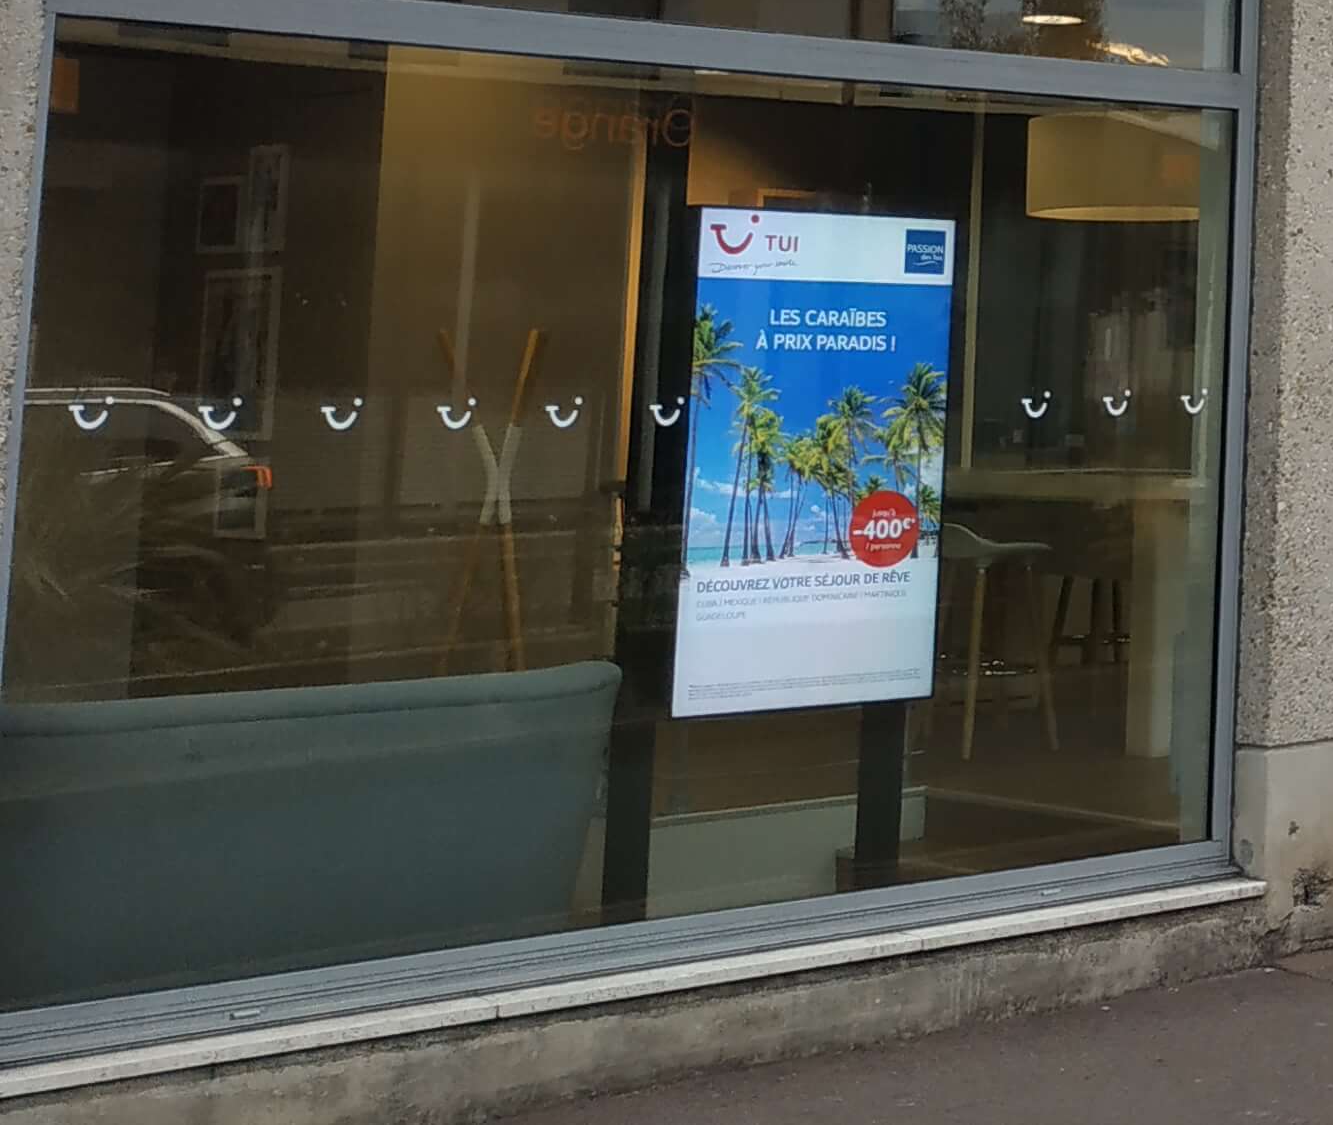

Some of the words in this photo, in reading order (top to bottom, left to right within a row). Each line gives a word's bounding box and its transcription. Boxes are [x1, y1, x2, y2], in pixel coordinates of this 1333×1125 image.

[765, 235, 799, 252] TUI
[907, 243, 944, 255] PASSION
[769, 308, 801, 327] LES
[804, 307, 887, 328] CARAÏBES
[756, 330, 768, 350] À
[773, 333, 813, 351] PRIX
[816, 333, 888, 351] PARADIS
[696, 578, 770, 594] DÉCOUVREZ
[773, 576, 812, 590] VOTRE
[814, 572, 860, 587] SÉJOUR
[864, 573, 879, 585] DE
[882, 569, 911, 583] RÊVE
